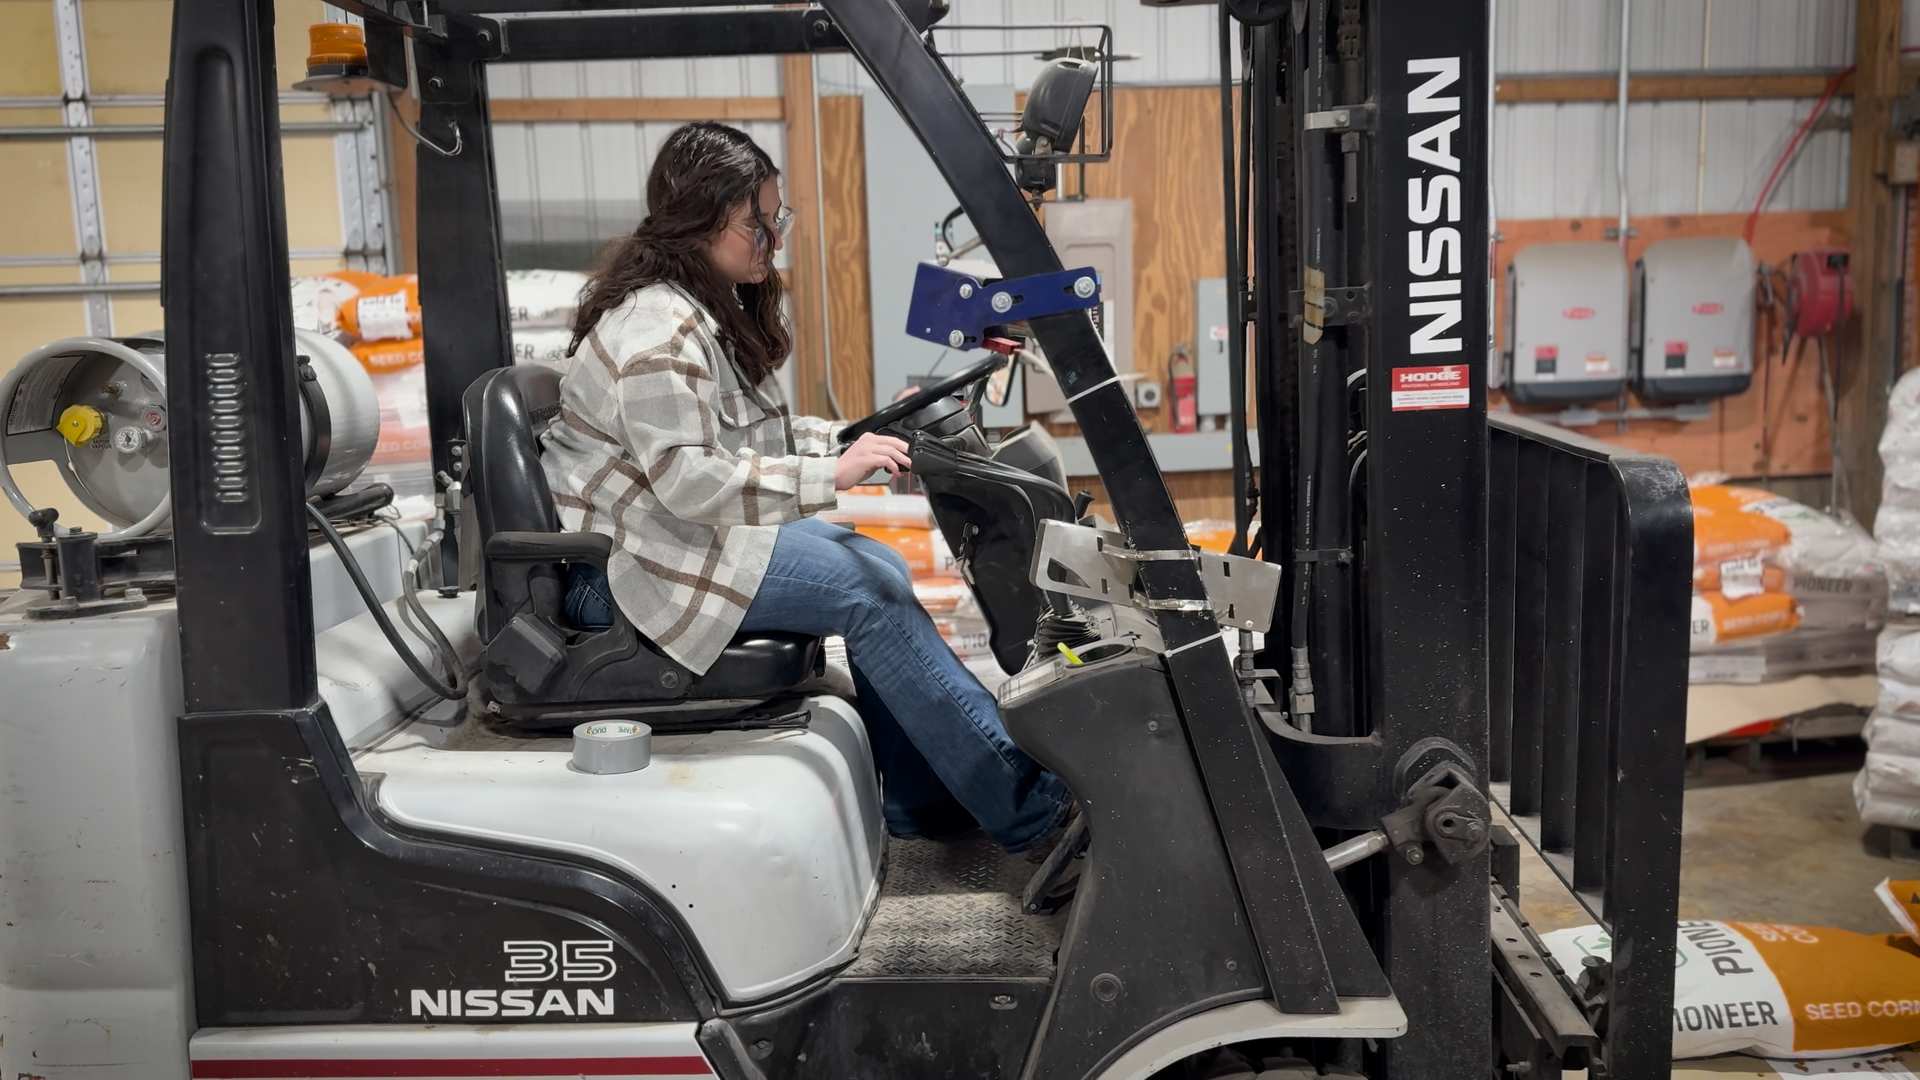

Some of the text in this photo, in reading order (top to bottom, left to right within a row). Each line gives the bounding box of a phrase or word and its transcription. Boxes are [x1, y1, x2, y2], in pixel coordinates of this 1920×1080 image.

[1407, 57, 1463, 354] NISSAN
[1400, 371, 1461, 382] HODGE
[1793, 577, 1852, 593] PIONEER
[504, 940, 616, 982] 35
[411, 988, 614, 1017] NISSAN
[1805, 1002, 1862, 1019] SEED
